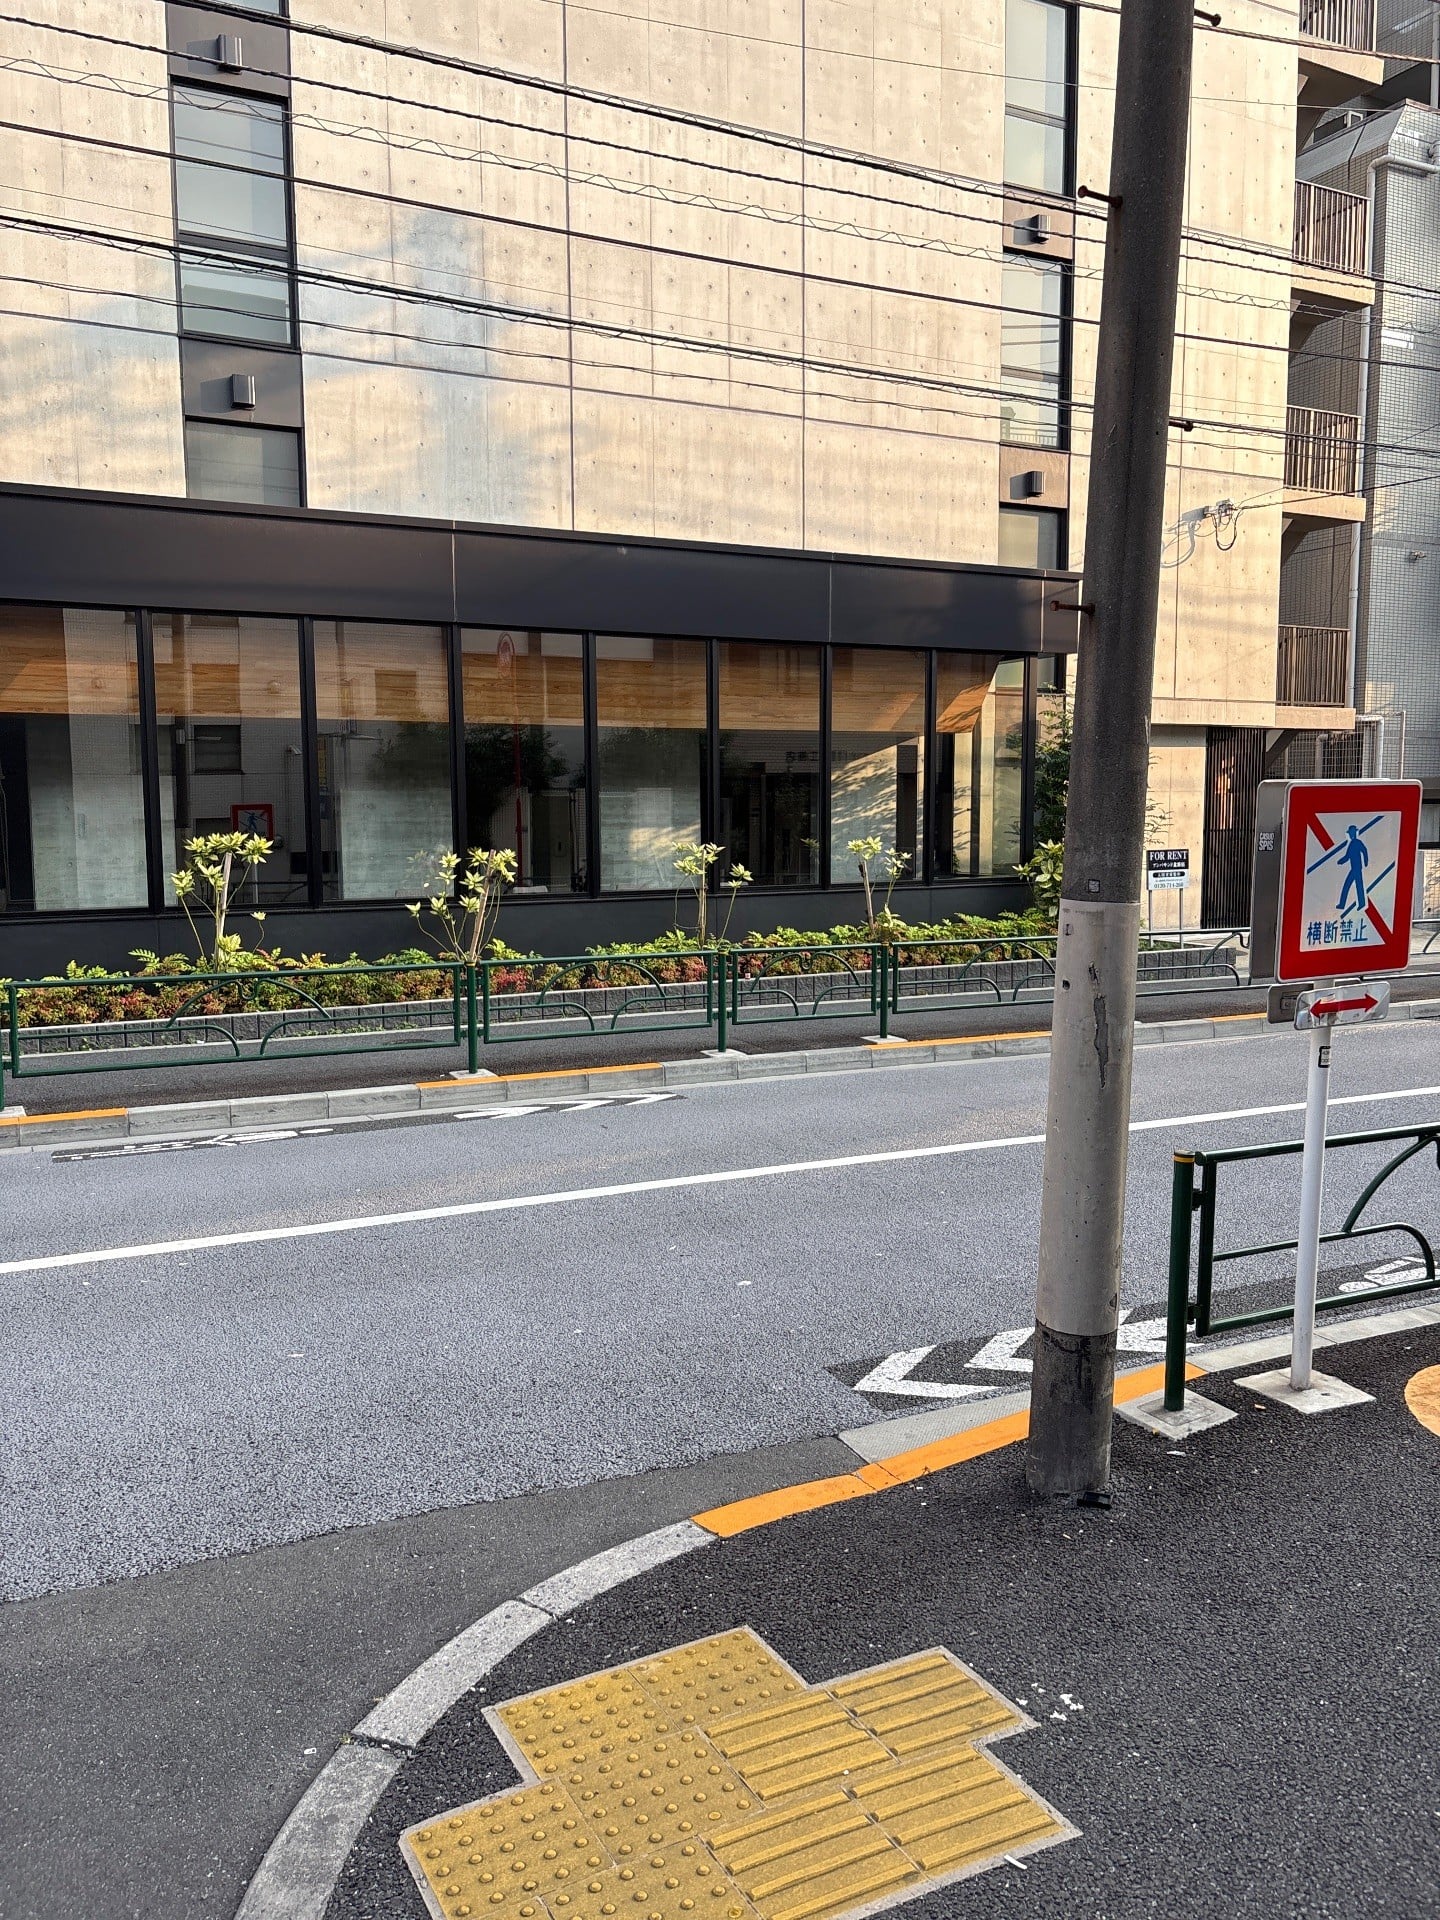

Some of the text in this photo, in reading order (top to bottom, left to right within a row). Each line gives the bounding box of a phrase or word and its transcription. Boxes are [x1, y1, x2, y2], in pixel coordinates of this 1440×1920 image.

[1149, 851, 1187, 861] FOR RENT
[1306, 918, 1368, 946] 横断禁止
